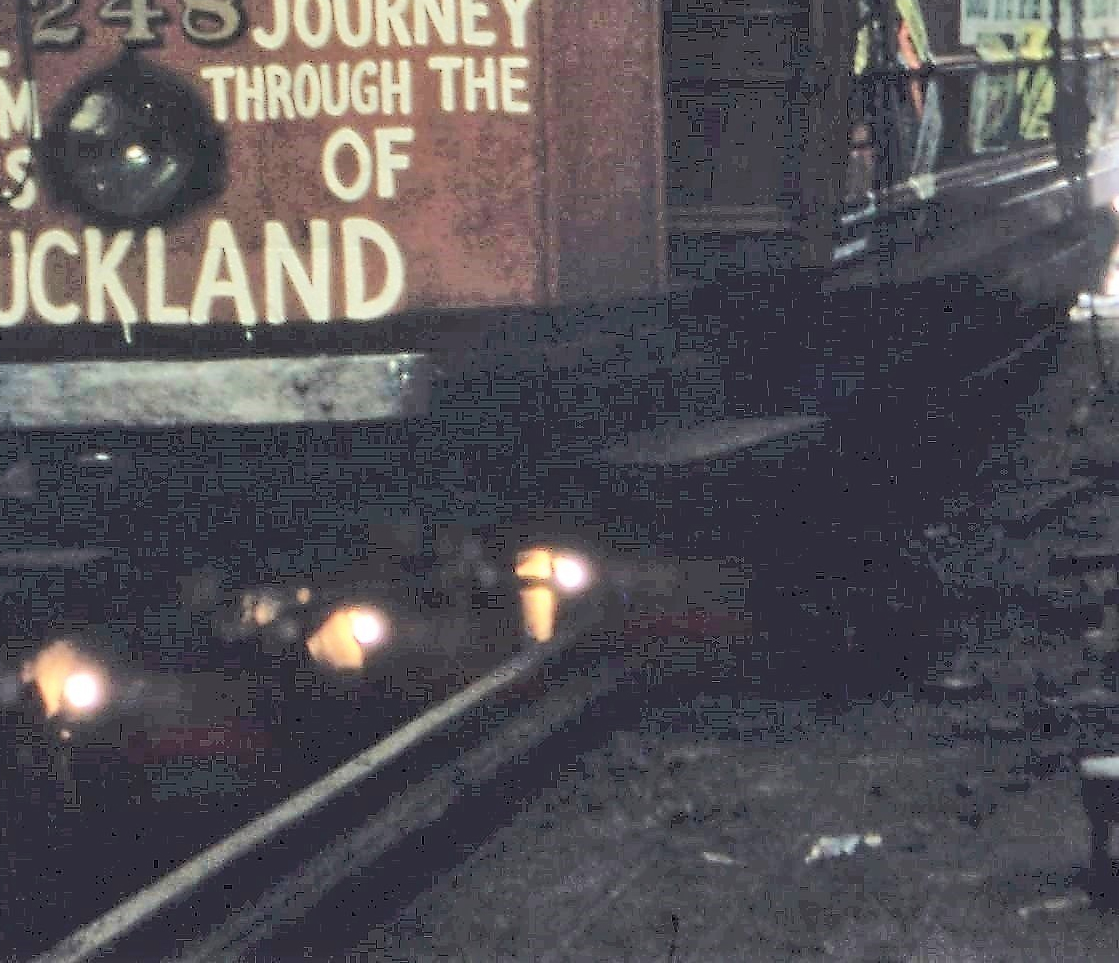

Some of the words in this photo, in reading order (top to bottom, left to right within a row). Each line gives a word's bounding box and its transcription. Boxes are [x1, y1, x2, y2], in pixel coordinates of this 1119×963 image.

[201, 59, 412, 124] THROUGH
[428, 54, 531, 113] THE
[321, 127, 415, 202] OF
